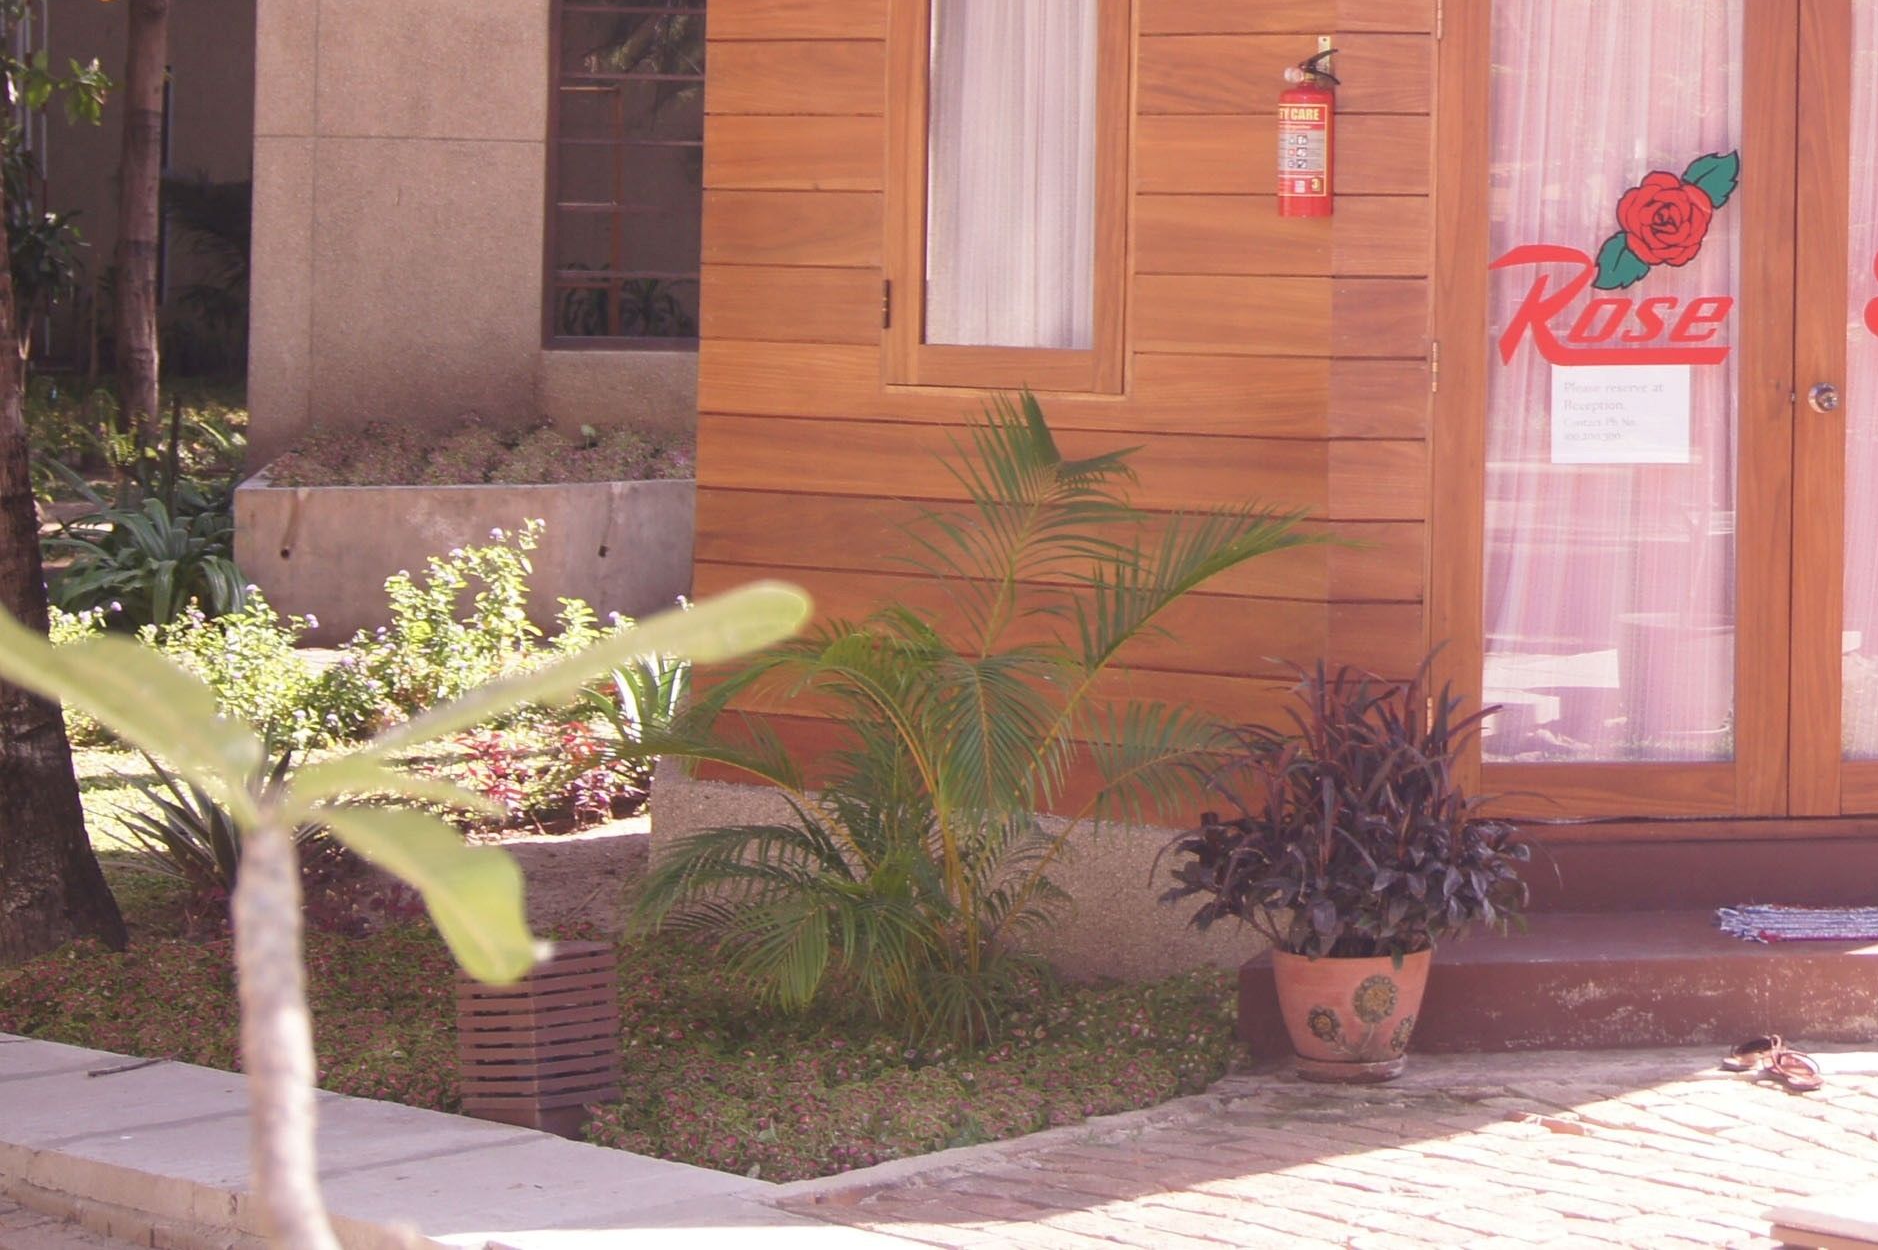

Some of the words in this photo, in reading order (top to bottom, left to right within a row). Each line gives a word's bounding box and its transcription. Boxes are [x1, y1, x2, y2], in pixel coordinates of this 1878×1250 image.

[1291, 108, 1320, 121] CARE
[1488, 244, 1734, 366] Rose
[1651, 383, 1665, 393] at
